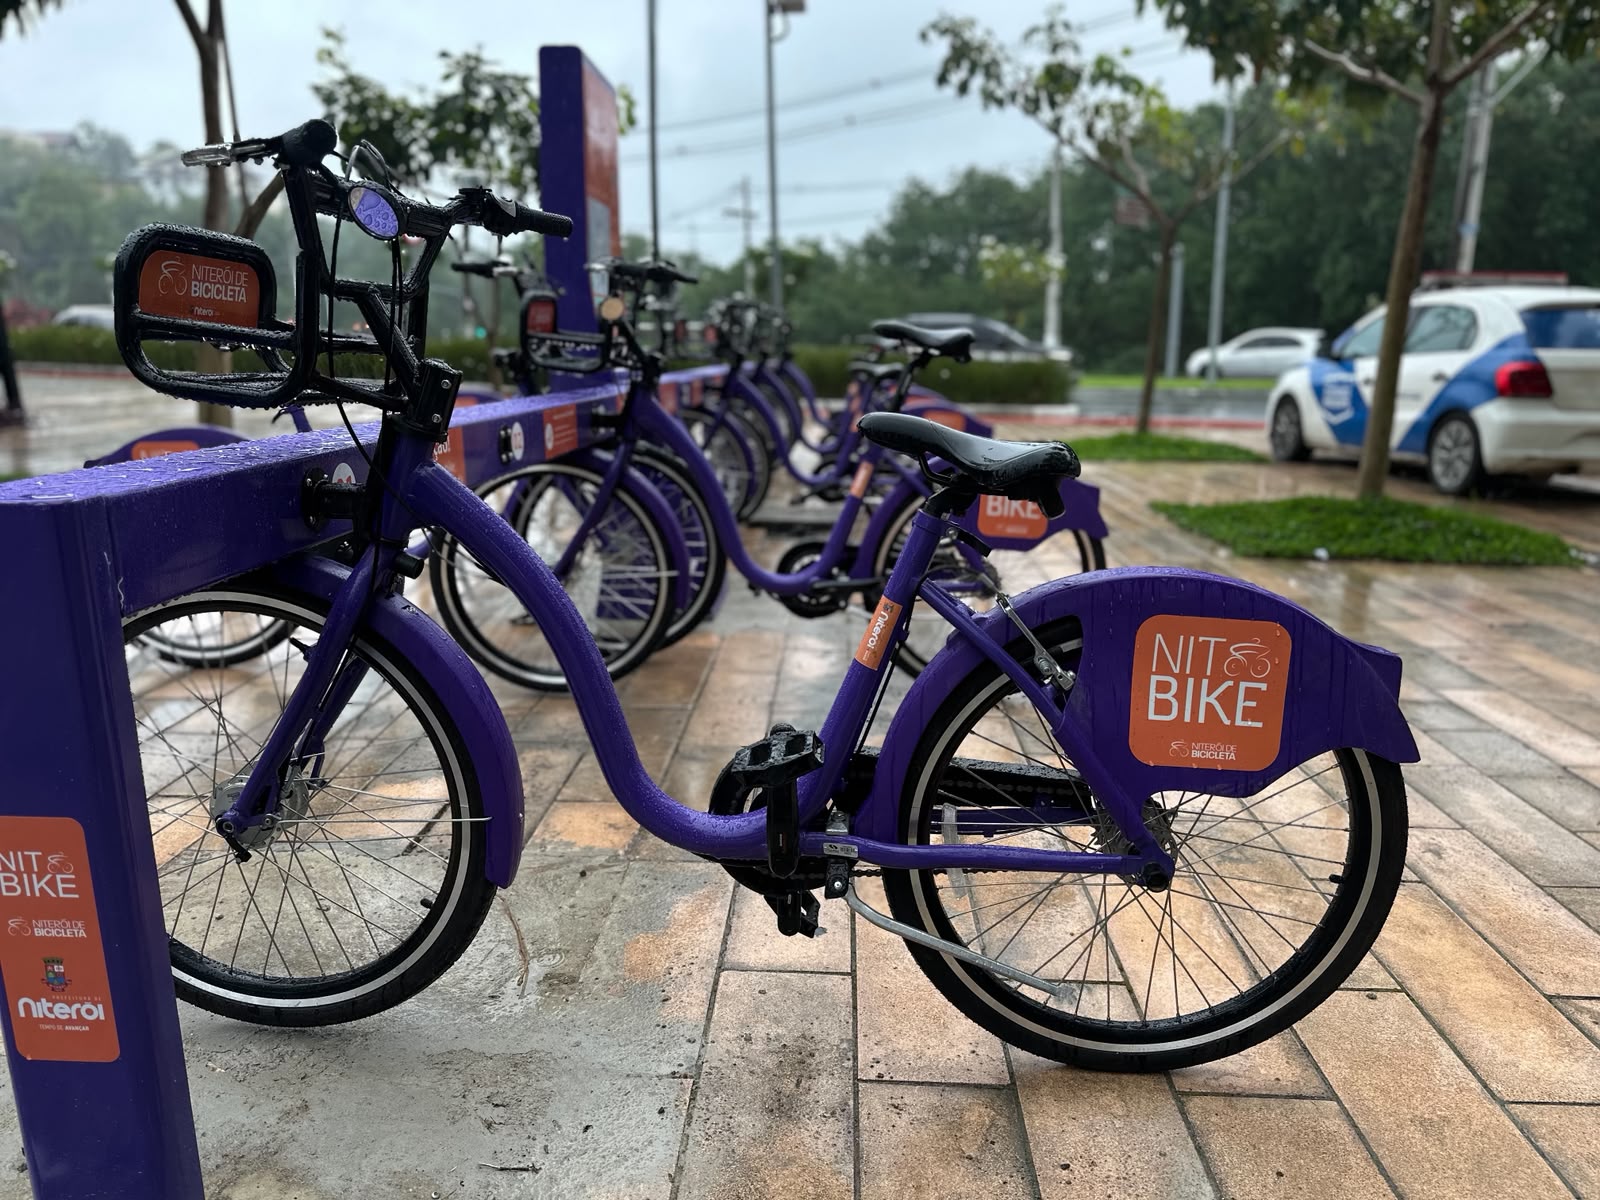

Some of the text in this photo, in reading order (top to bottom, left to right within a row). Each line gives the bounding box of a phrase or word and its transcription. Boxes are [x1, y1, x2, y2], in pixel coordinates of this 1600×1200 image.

[191, 263, 249, 287] NITERÓI DE
[191, 281, 247, 303] BICICLETA
[986, 495, 1041, 519] BIKE
[1151, 633, 1227, 676] NIT
[1147, 674, 1268, 728] BIKE
[1191, 742, 1237, 753] NITERÓI DE
[1191, 750, 1236, 760] BICICLETA
[0, 850, 42, 872] NIT
[0, 872, 80, 898] BIKE
[33, 927, 88, 938] BICICLETA
[72, 920, 86, 930] DE
